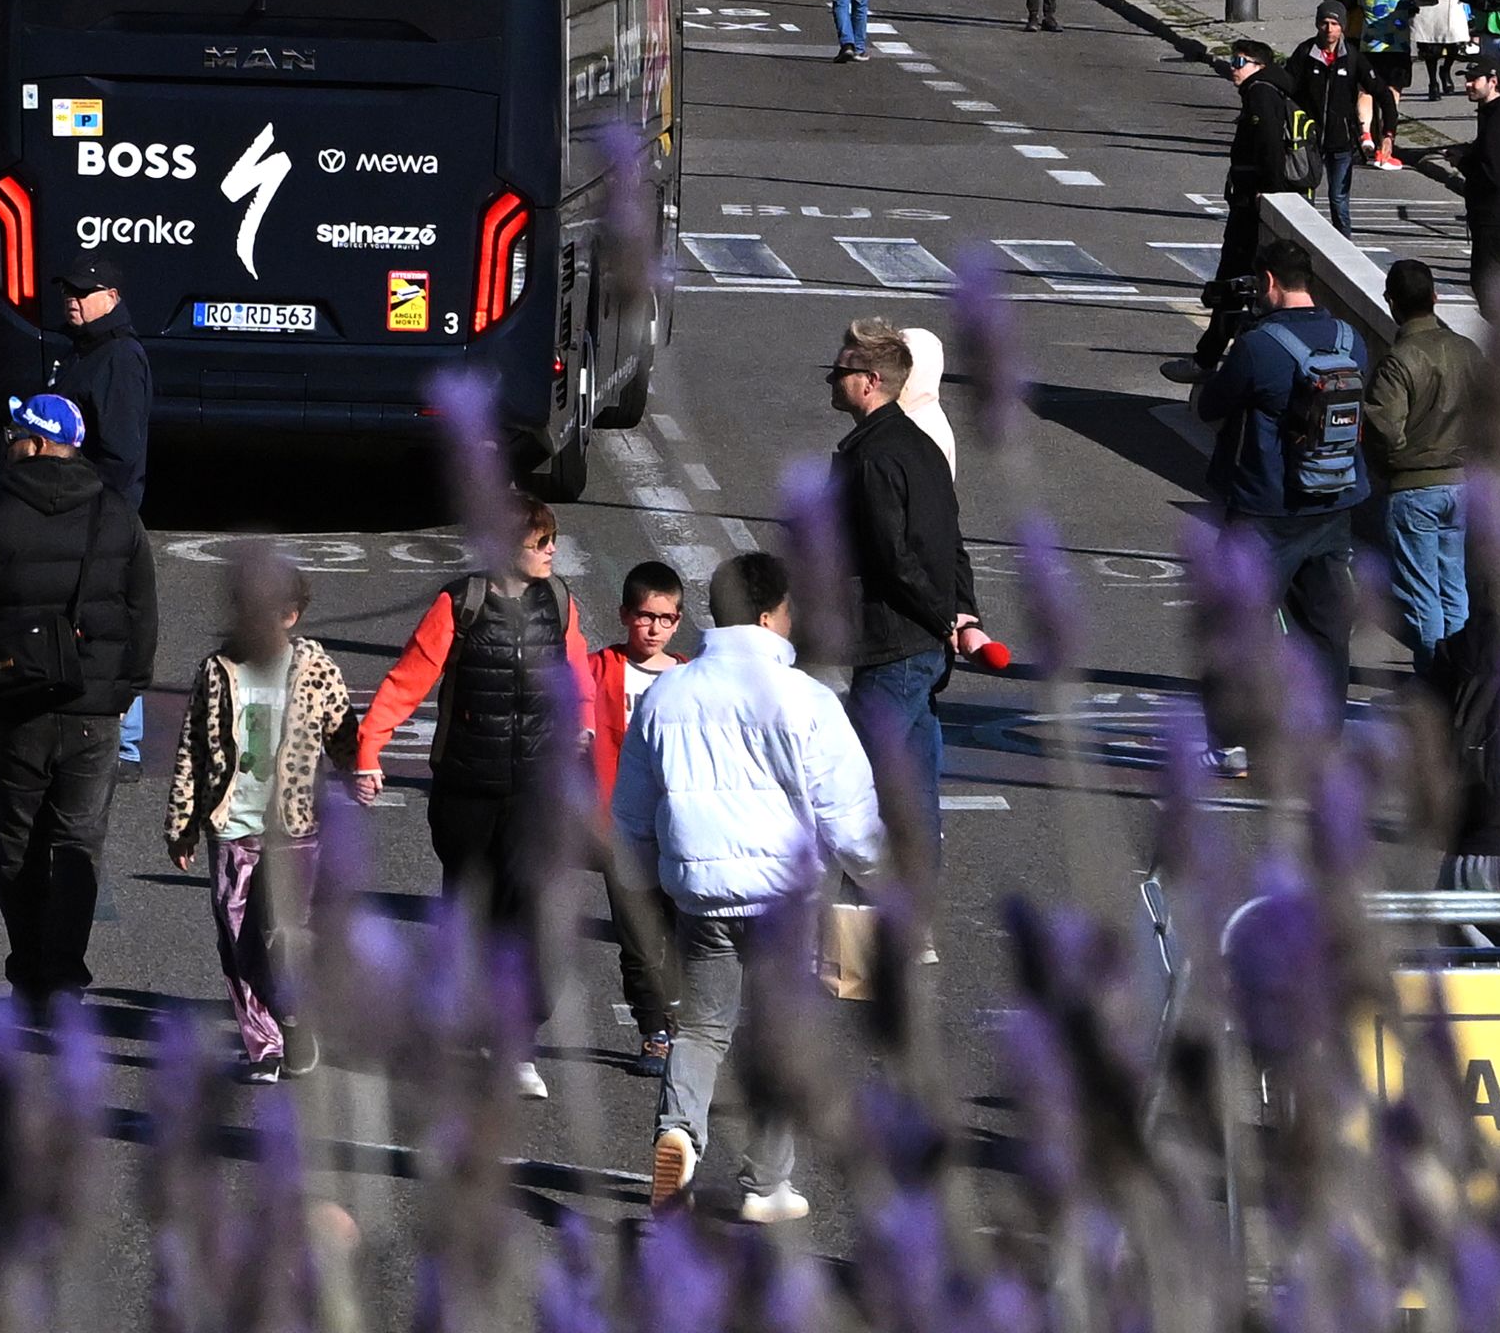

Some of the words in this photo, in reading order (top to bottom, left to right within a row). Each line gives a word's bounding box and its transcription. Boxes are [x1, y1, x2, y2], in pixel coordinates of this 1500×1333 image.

[203, 47, 317, 70] MAN
[77, 140, 197, 180] BOSS
[77, 214, 196, 250] grenke
[206, 304, 232, 325] RO
[443, 312, 459, 335] 3
